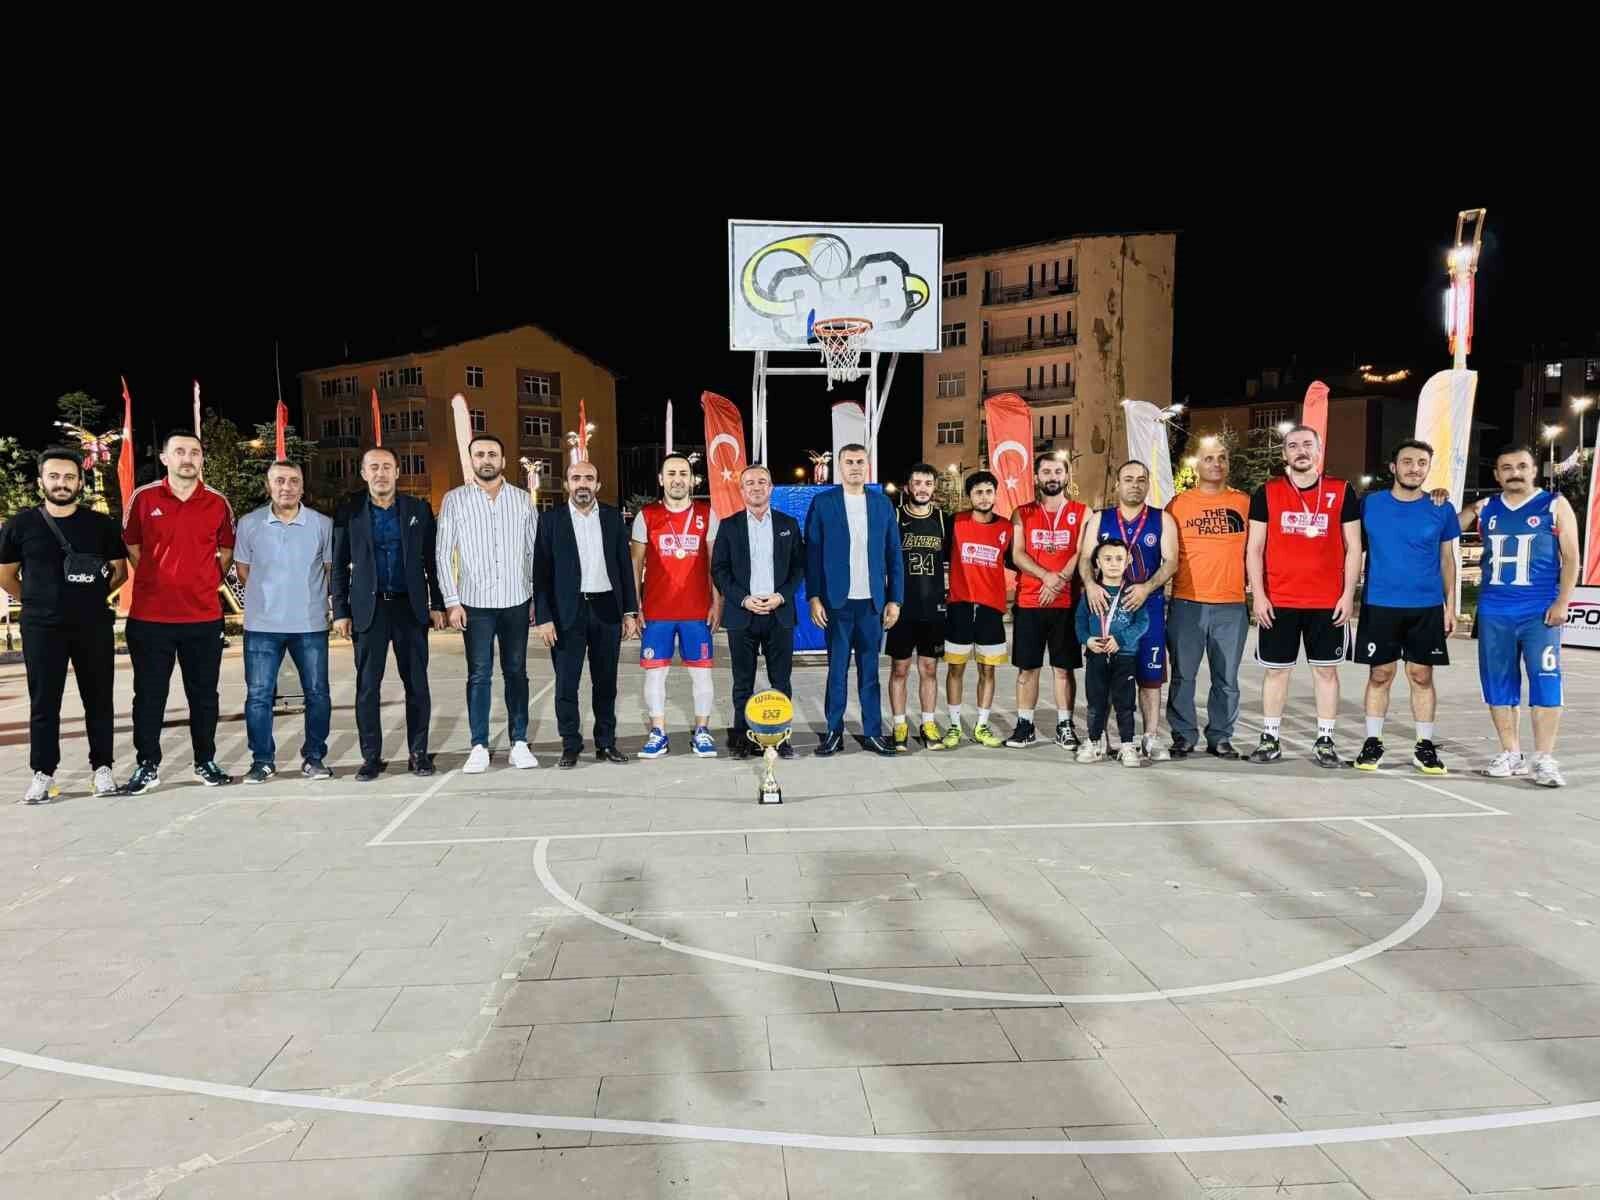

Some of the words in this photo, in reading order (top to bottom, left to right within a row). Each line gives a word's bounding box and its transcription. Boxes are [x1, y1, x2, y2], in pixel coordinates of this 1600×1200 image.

[1326, 492, 1336, 508] 7
[1067, 512, 1077, 525] 6
[1202, 508, 1225, 517] THE
[695, 515, 704, 529] 5
[1186, 517, 1227, 527] NORTH
[1488, 515, 1497, 530] 6
[1000, 530, 1007, 544] 4
[1199, 525, 1227, 535] FACE
[909, 552, 934, 575] 24
[1488, 533, 1537, 585] H
[1151, 646, 1160, 663] 7
[1367, 642, 1377, 657] 9
[1542, 645, 1556, 671] 6
